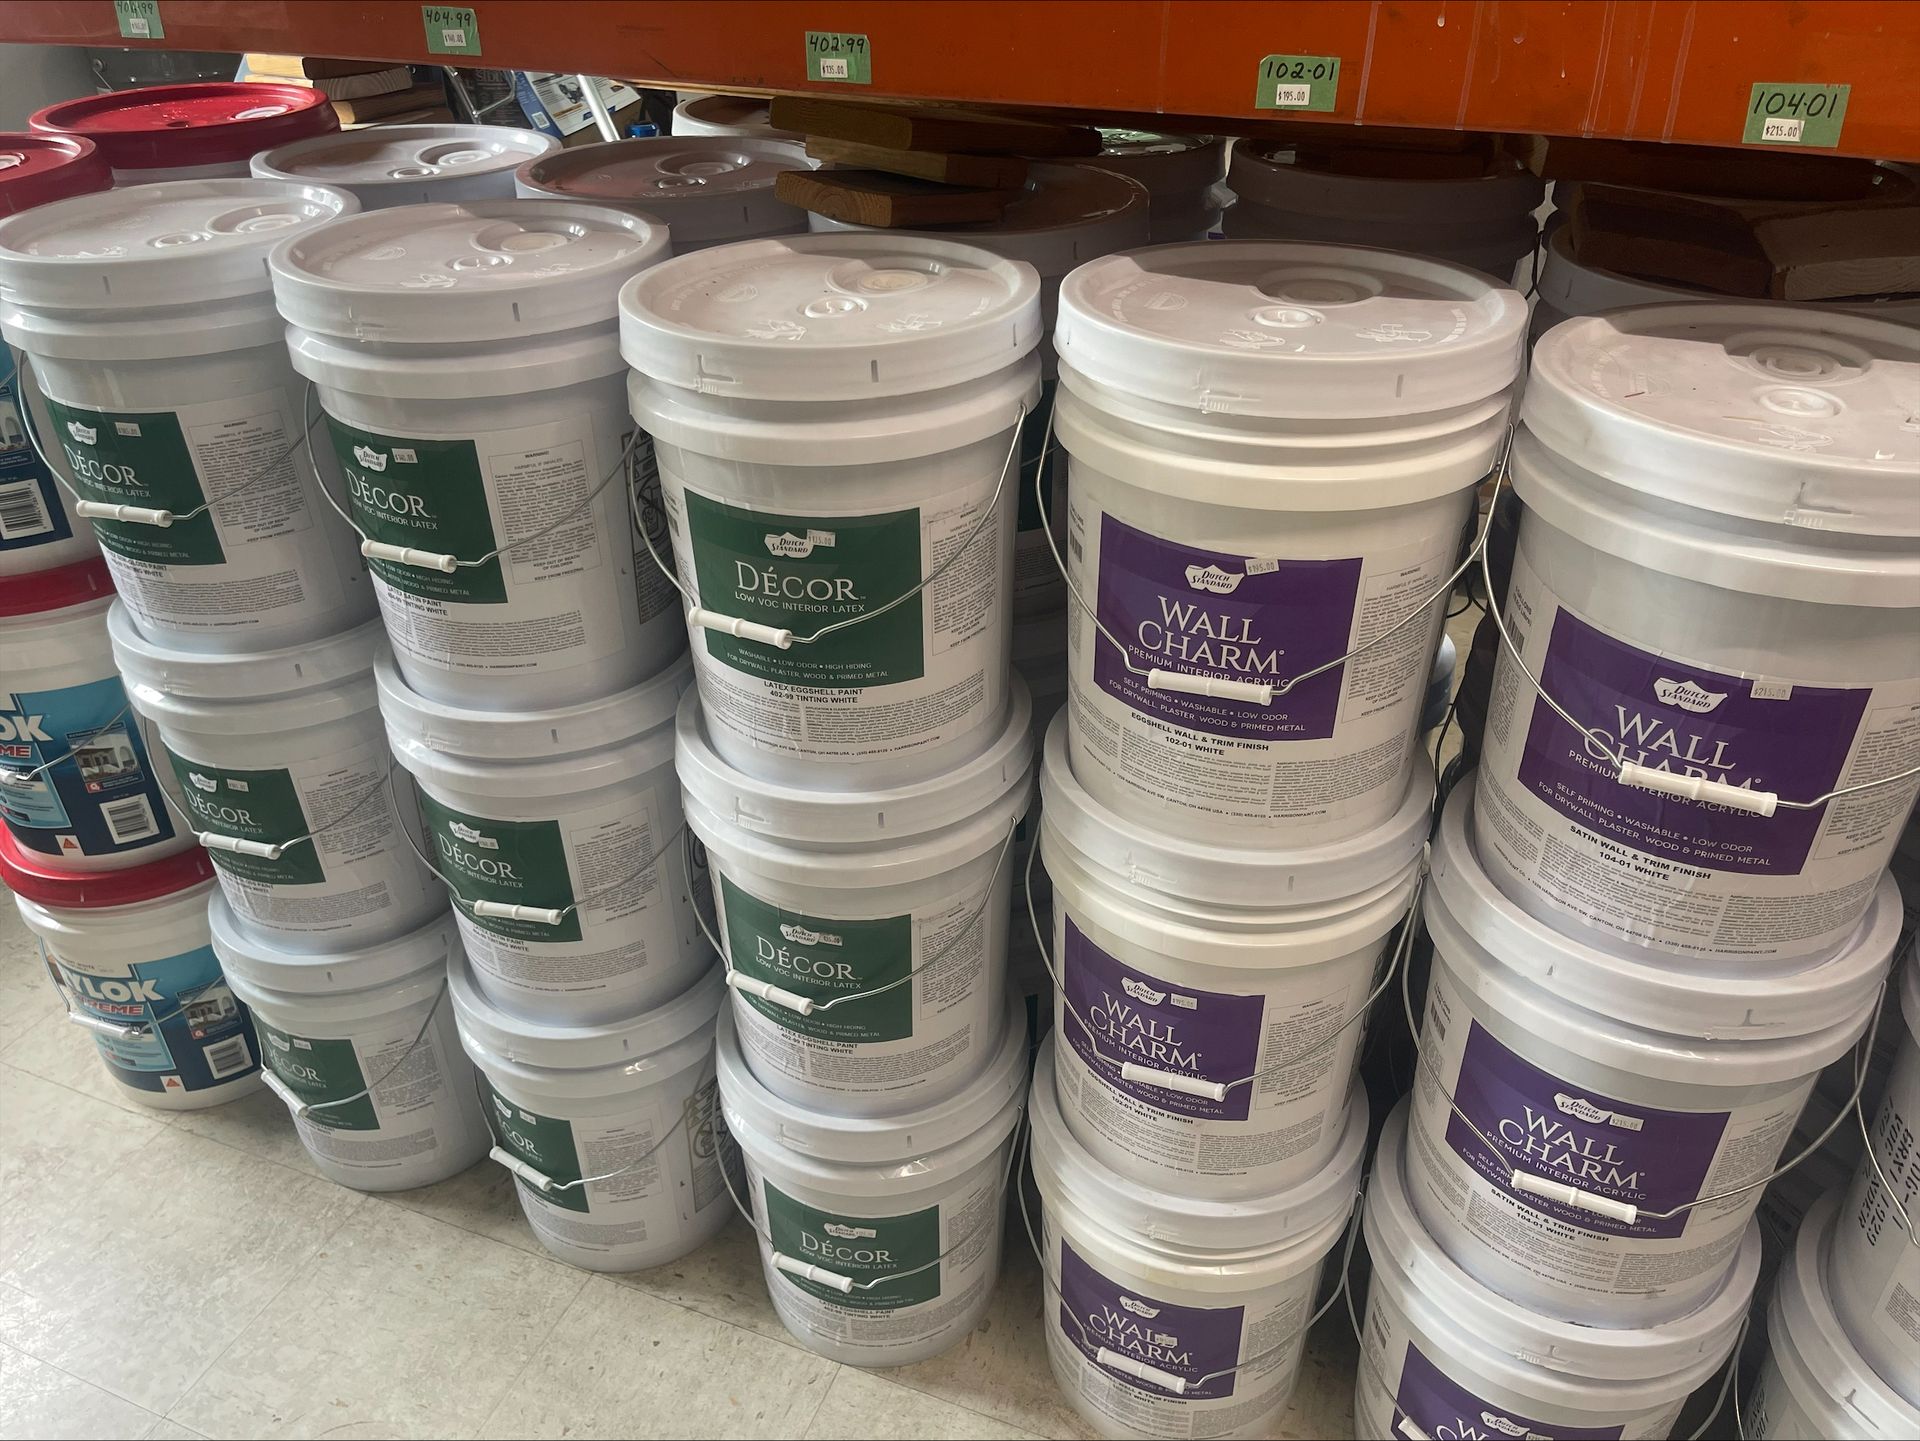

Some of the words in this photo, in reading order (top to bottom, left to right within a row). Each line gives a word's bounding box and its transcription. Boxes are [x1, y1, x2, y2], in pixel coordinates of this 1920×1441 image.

[1278, 91, 1306, 102] $195.00
[1765, 125, 1798, 138] $215.00
[63, 443, 143, 486] DÉCOR
[345, 467, 431, 518] DÉCOR
[411, 520, 437, 530] LATEX
[771, 543, 809, 553] STANDARD
[780, 538, 805, 547] DUTCH
[735, 560, 859, 601] DÉCOR
[1191, 575, 1233, 589] STANDARD
[1201, 570, 1230, 582] DUTCH
[735, 591, 755, 603] LOW
[757, 597, 779, 608] VOC
[782, 602, 829, 613] INTERIOR
[832, 604, 865, 613] LATEX
[1157, 595, 1262, 645] WALL
[738, 648, 771, 663] WASHABLE
[1128, 645, 1172, 669] PREMIUM
[1177, 663, 1231, 681] INTERIOR
[1138, 620, 1280, 675] CHARM
[764, 681, 789, 692] LATEX
[790, 687, 836, 696] EGGSHELL
[838, 688, 864, 696] PAINT
[803, 672, 826, 680] WOOD
[865, 670, 889, 679] METAL
[770, 690, 794, 700] 402-99
[795, 694, 829, 703] TINTING
[1109, 679, 1122, 691] FOR
[1199, 715, 1229, 727] WOOD
[1241, 722, 1274, 732] PRIMED
[1123, 677, 1139, 689] SELF
[1140, 686, 1172, 703] PRIMING
[1180, 700, 1228, 716] WASHABLE
[1237, 711, 1259, 720] LOW
[1261, 713, 1288, 721] ODOR
[1659, 688, 1711, 709] STANDARD
[1673, 685, 1710, 700] DUTCH
[1131, 711, 1172, 734] EGGSHELL
[1174, 727, 1199, 741] WALL
[1210, 738, 1234, 748] TRIM
[1236, 742, 1269, 751] FINISH
[1165, 735, 1192, 749] 102-01
[1194, 744, 1225, 756] WHITE
[1614, 704, 1736, 770] WALL
[1568, 750, 1620, 781] PREMIUM
[1538, 781, 1553, 796] FOR
[1645, 835, 1679, 852] WOOD
[1693, 849, 1733, 862] PRIMED
[1736, 855, 1771, 866] METAL
[1557, 782, 1576, 798] SELF
[1577, 793, 1614, 818] PRIMING
[1624, 816, 1680, 840] WASHABLE
[1692, 837, 1717, 848] LOW
[1720, 842, 1753, 853] ODOR
[438, 832, 517, 879] DÉCOR
[1570, 825, 1598, 844] SATIN
[1599, 840, 1628, 858] WALL
[1642, 857, 1671, 871] TRIM
[1672, 864, 1712, 880] FINISH
[1599, 850, 1631, 868] 104-01
[1634, 864, 1670, 881] WHITE
[756, 935, 856, 980] DÉCOR
[773, 966, 790, 977] VOC
[792, 973, 831, 986] INTERIOR
[833, 981, 861, 989] LATEX
[1134, 984, 1156, 997] DUTCH
[1127, 986, 1158, 1002] STANDARD
[1102, 991, 1183, 1046] WALL
[1090, 1006, 1200, 1071] CHARM
[1118, 1045, 1159, 1069] INTERIOR
[1164, 1066, 1207, 1081] ACRYLIC
[1118, 1091, 1137, 1106] WALL
[1145, 1106, 1165, 1117] TRIM
[1166, 1113, 1194, 1125] FINISH
[1134, 1109, 1158, 1122] WHITE
[1136, 1088, 1160, 1101] WOOD
[1169, 1100, 1197, 1111] PRIMED
[1199, 1106, 1224, 1114] METAL
[1185, 1096, 1208, 1105] ODOR
[1560, 1101, 1601, 1121] STANDARD
[1570, 1101, 1599, 1115] DUTCH
[1522, 1105, 1624, 1166] WALL
[1478, 1152, 1494, 1167] SELF
[1486, 1130, 1531, 1164] PREMIUM
[1535, 1161, 1589, 1188] INTERIOR
[1594, 1185, 1647, 1200] ACRYLIC
[1498, 1119, 1639, 1190] CHARM
[1463, 1148, 1476, 1161] FOR
[1553, 1206, 1581, 1220] WOOD
[1594, 1219, 1628, 1230] PRIMED
[1629, 1224, 1657, 1233] METAL
[1490, 1188, 1515, 1206] SATIN
[1516, 1204, 1541, 1220] WALL
[1552, 1222, 1576, 1234] TRIM
[1577, 1229, 1609, 1242] FINISH
[1516, 1212, 1544, 1230] 104-01
[1546, 1227, 1576, 1240] WHITE
[800, 1231, 894, 1263] DÉCOR
[1089, 1314, 1191, 1366] CHARM
[1117, 1346, 1156, 1365] INTERIOR
[1160, 1363, 1198, 1373] ACRYLIC
